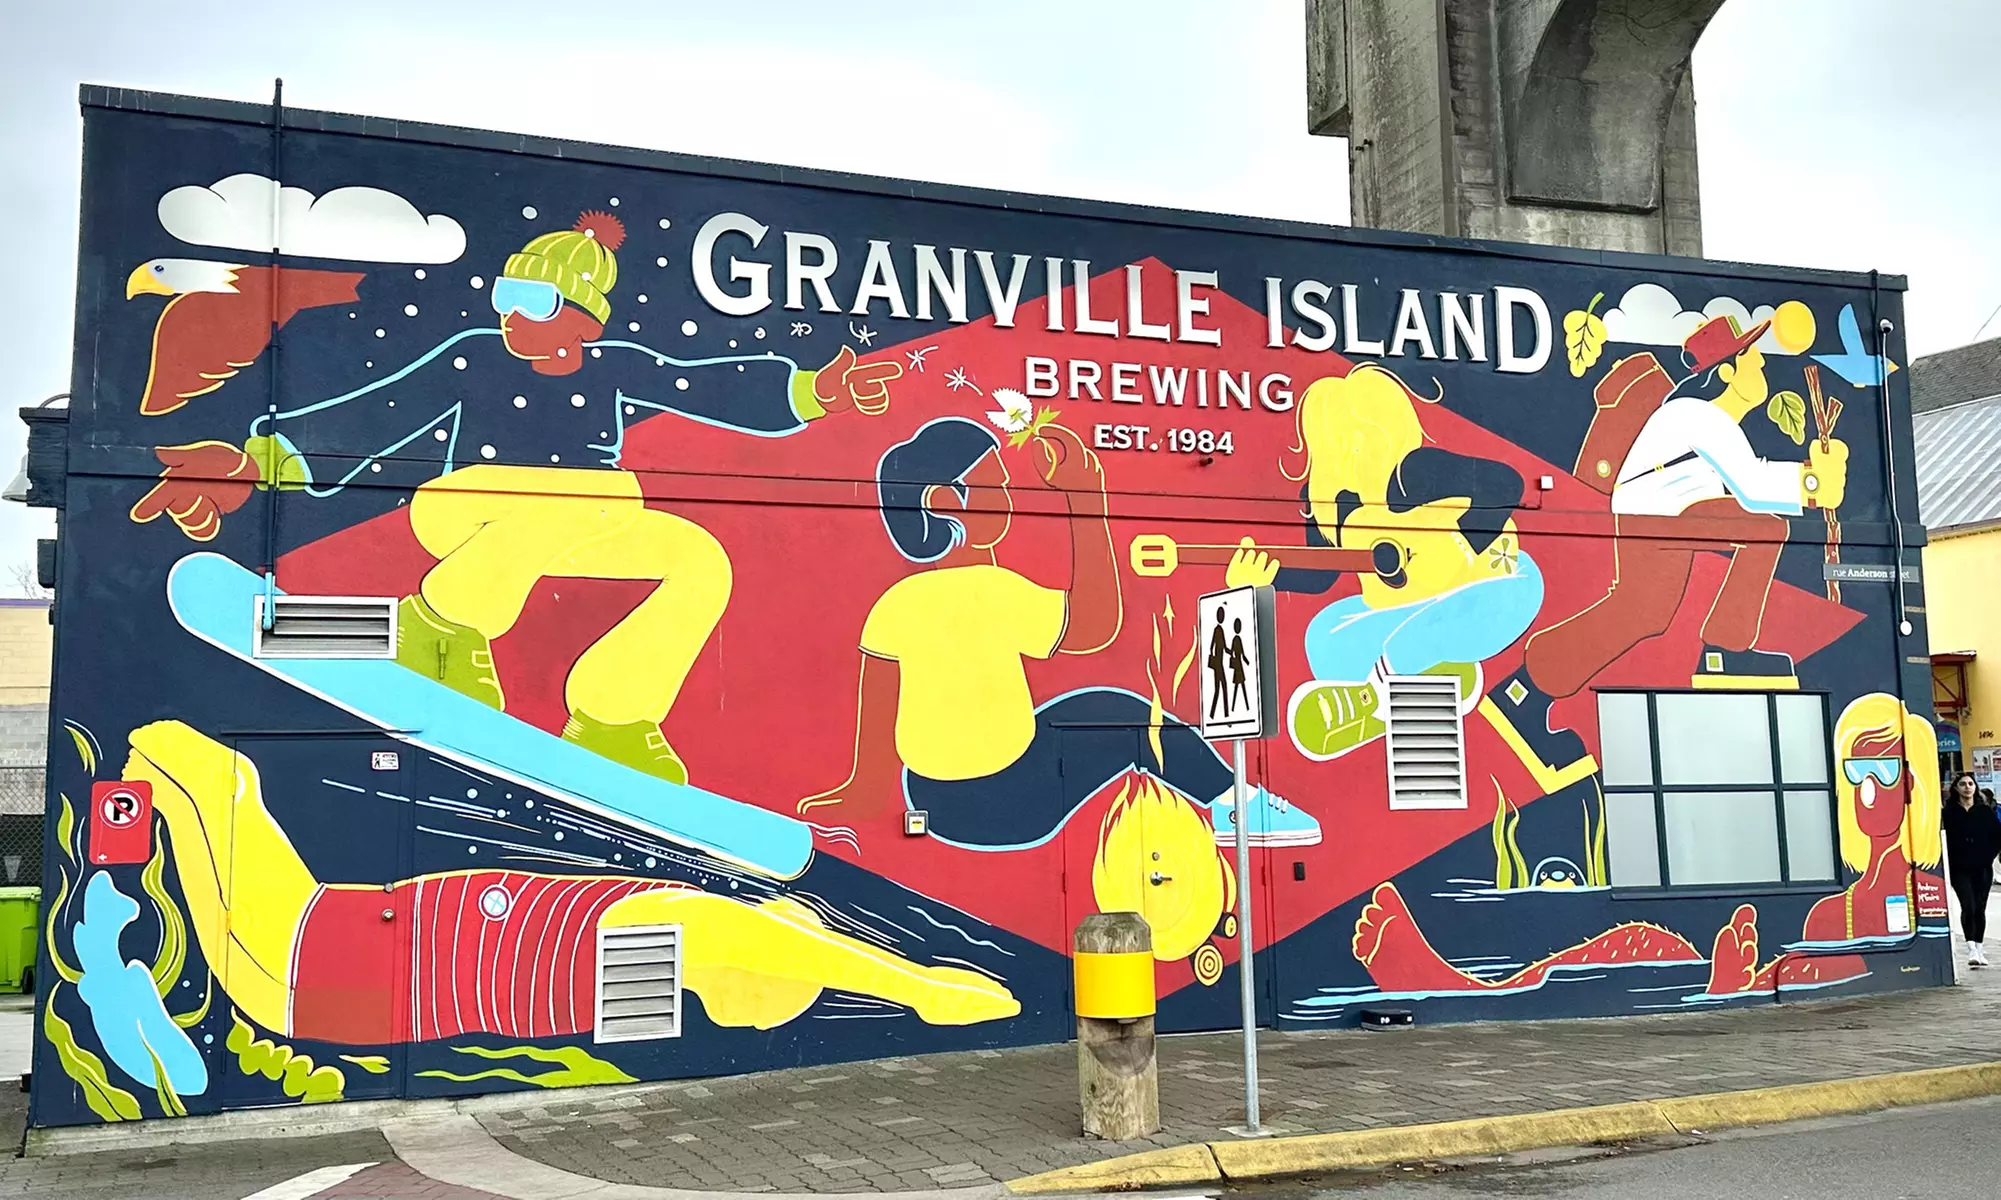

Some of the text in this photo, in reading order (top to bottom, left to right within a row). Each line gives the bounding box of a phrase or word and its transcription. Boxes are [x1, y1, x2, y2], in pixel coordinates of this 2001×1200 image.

[691, 212, 1553, 374] GRANVILLE ISLAND
[1025, 355, 1295, 412] BREWING
[1094, 424, 1235, 455] EST. 1984
[1832, 567, 1910, 579] rue Anderson stet
[113, 797, 134, 821] P
[1917, 882, 1939, 891] Andrew
